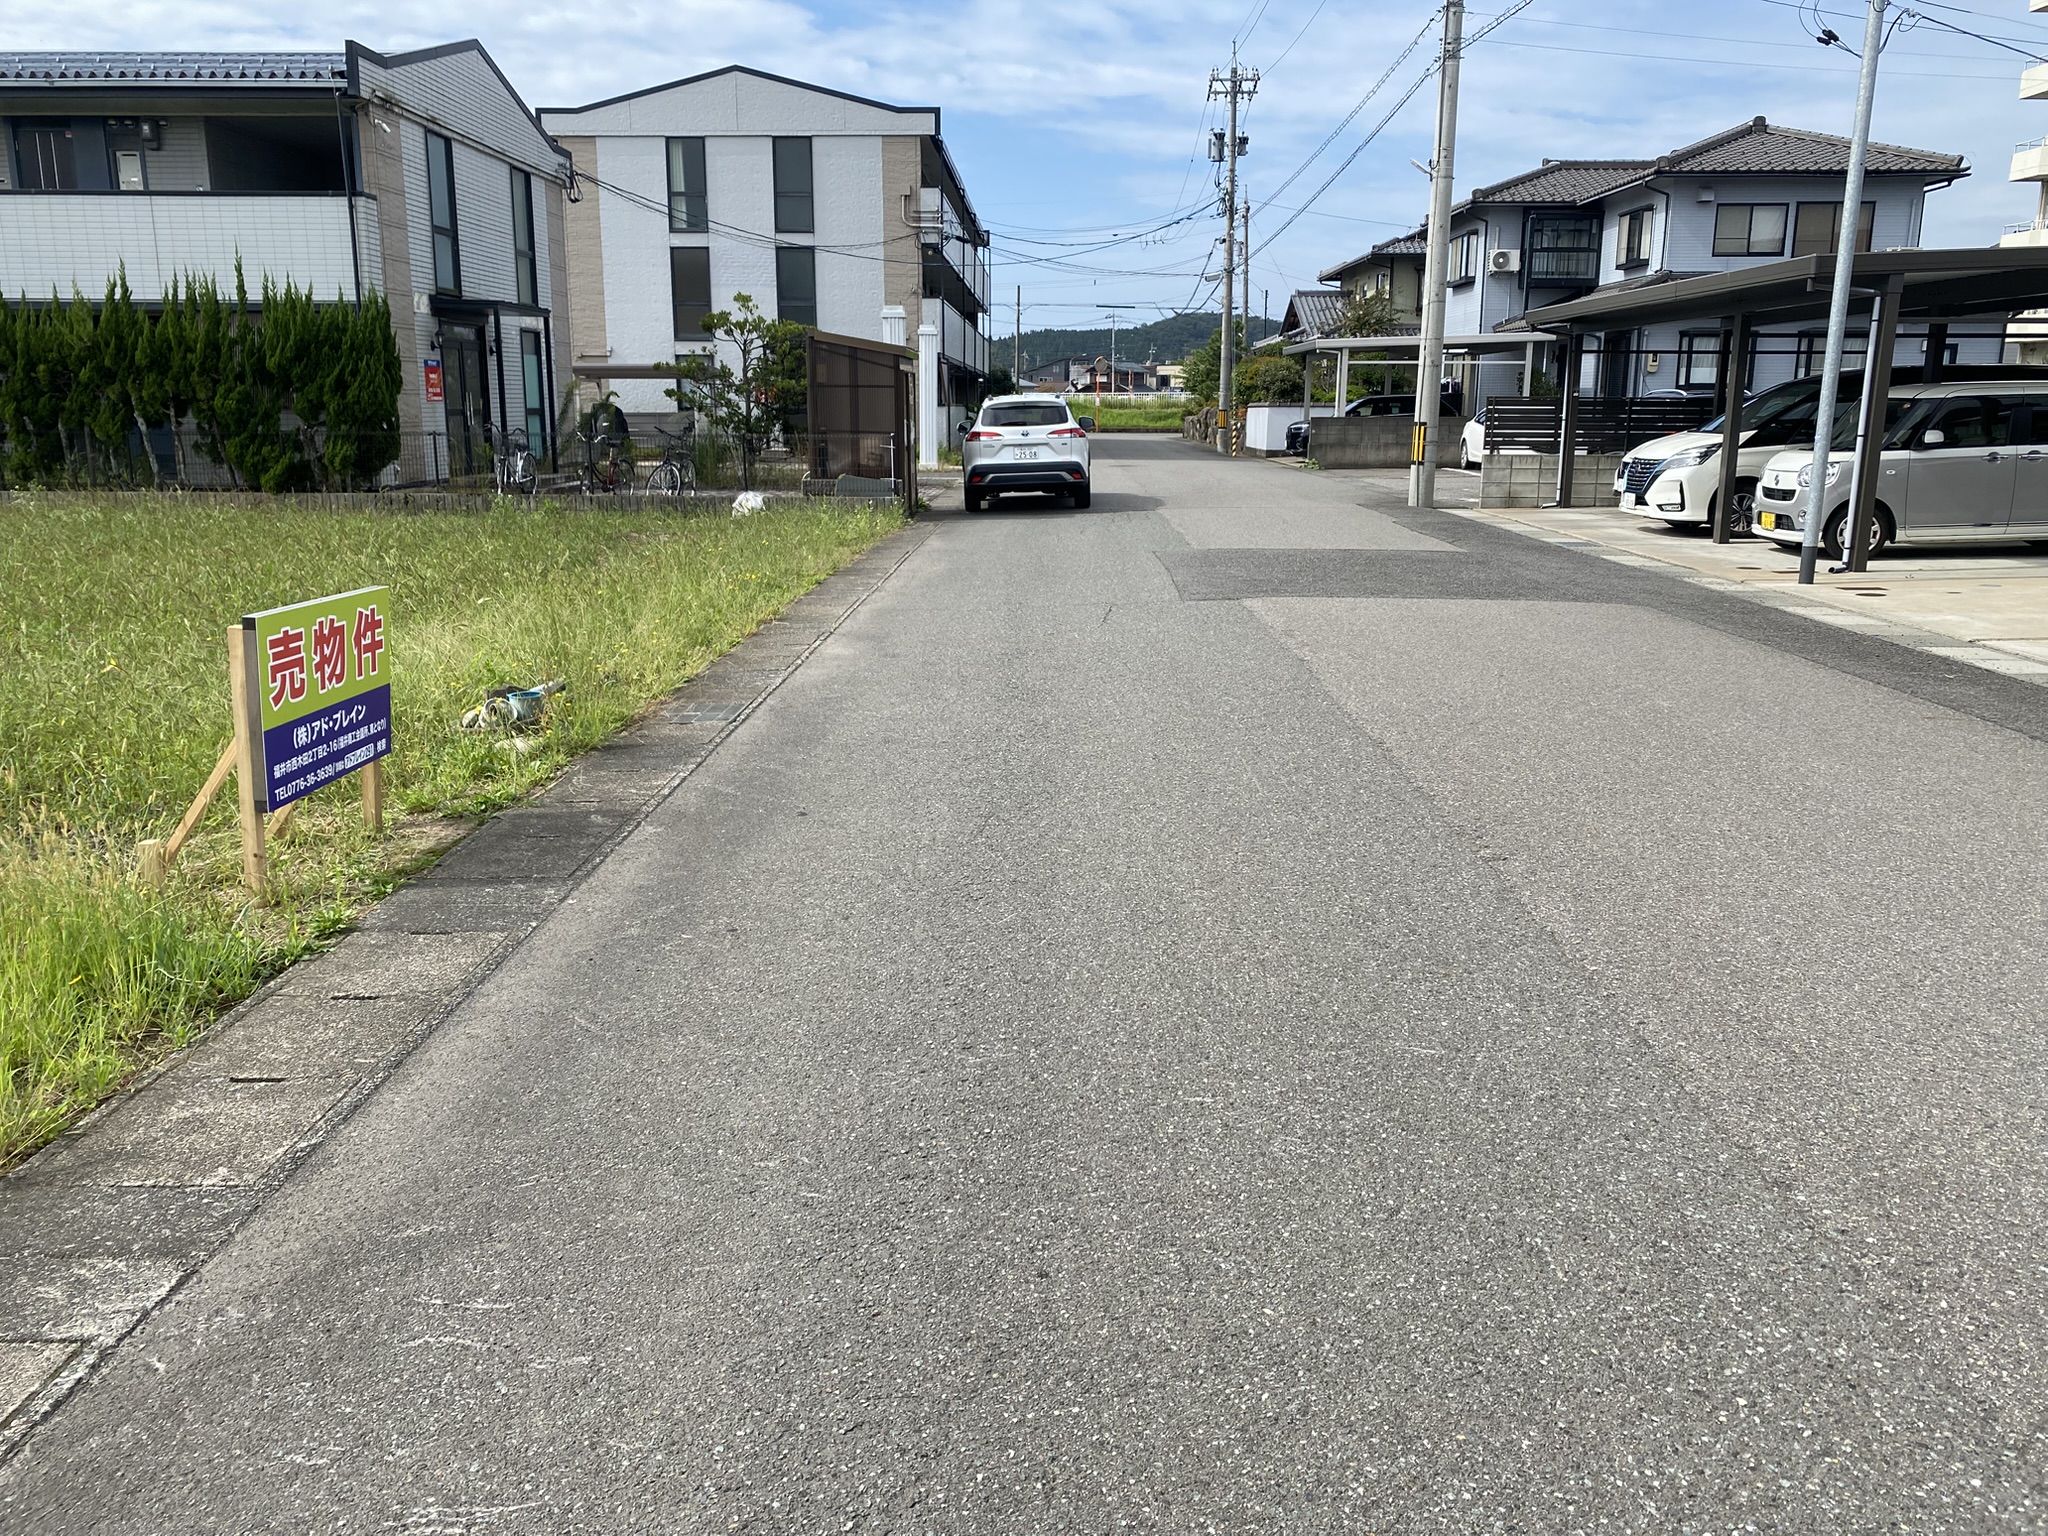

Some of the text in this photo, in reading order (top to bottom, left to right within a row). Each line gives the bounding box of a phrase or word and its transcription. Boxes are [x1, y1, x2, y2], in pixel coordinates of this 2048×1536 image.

[267, 605, 384, 710] 売物件
[293, 704, 366, 749] (株)アド・ブレイン
